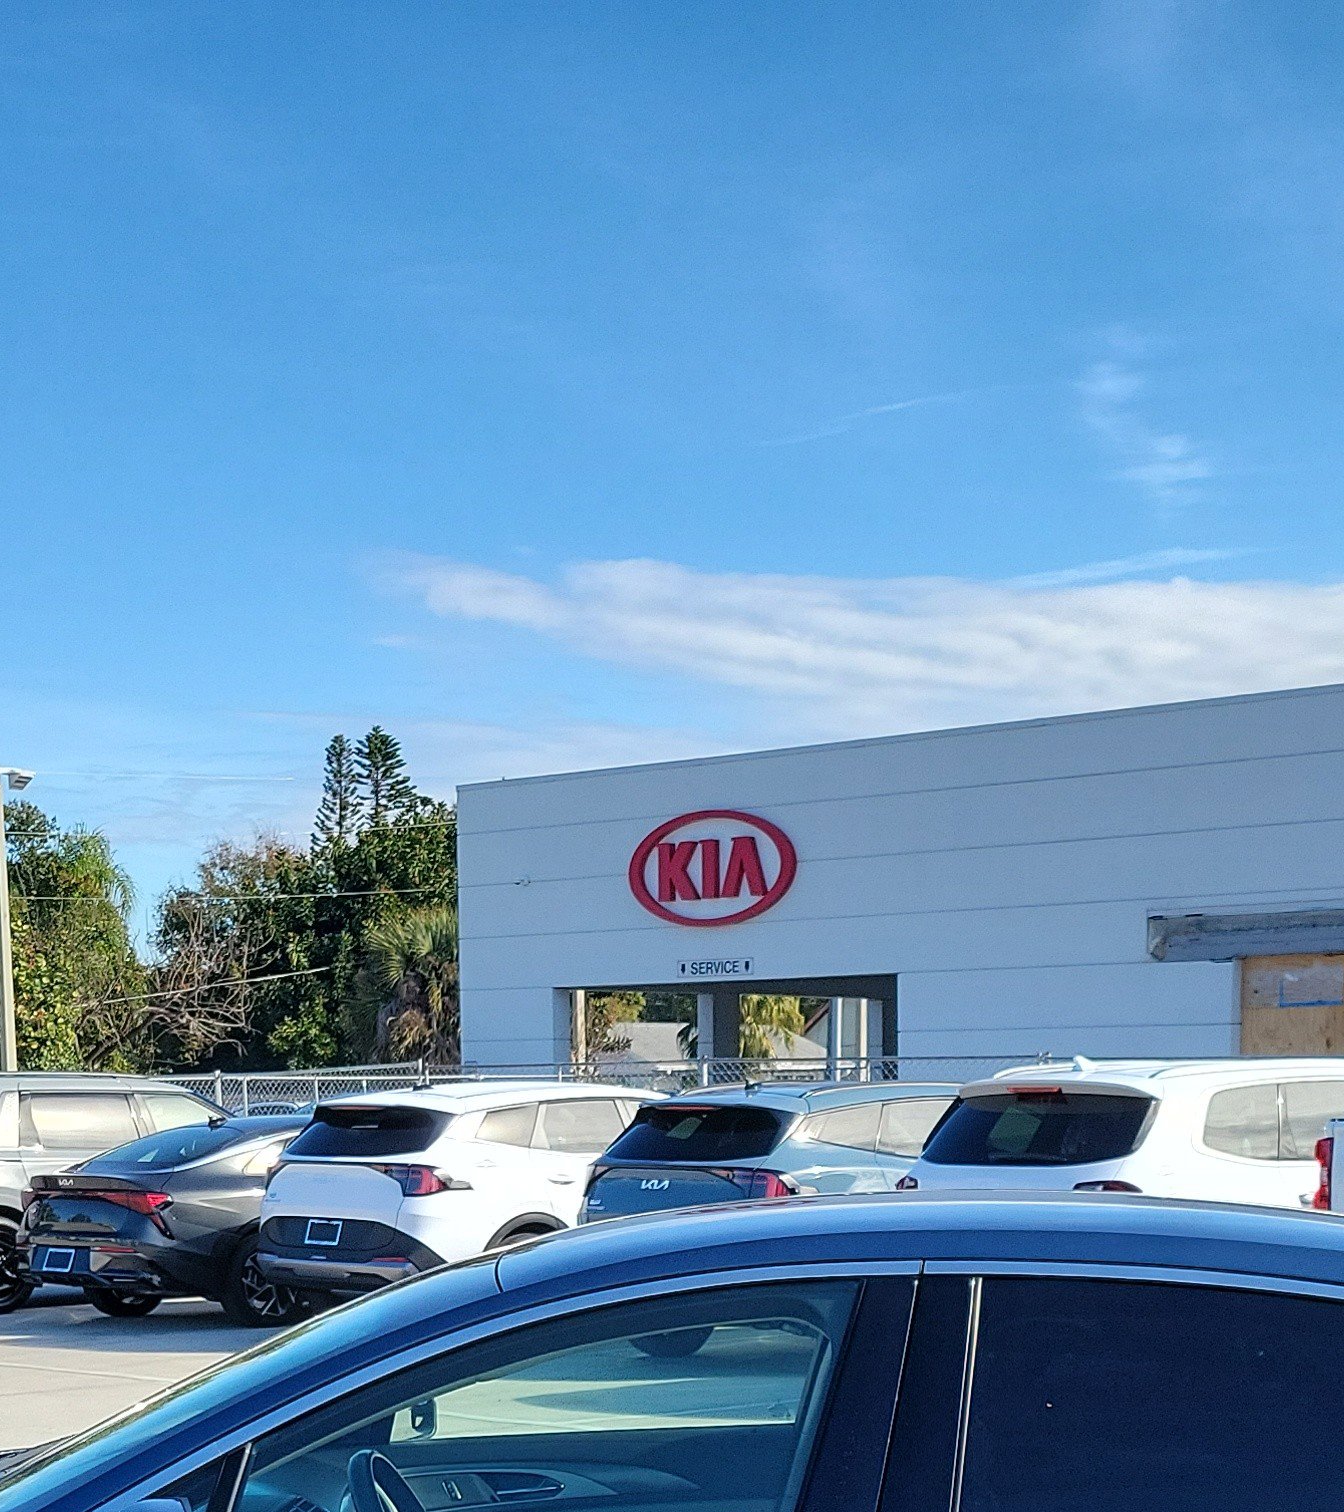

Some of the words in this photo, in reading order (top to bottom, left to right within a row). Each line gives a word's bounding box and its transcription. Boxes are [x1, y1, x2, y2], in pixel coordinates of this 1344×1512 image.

[657, 836, 770, 902] KIA
[690, 960, 740, 975] SERVICE
[640, 1179, 670, 1190] KIA
